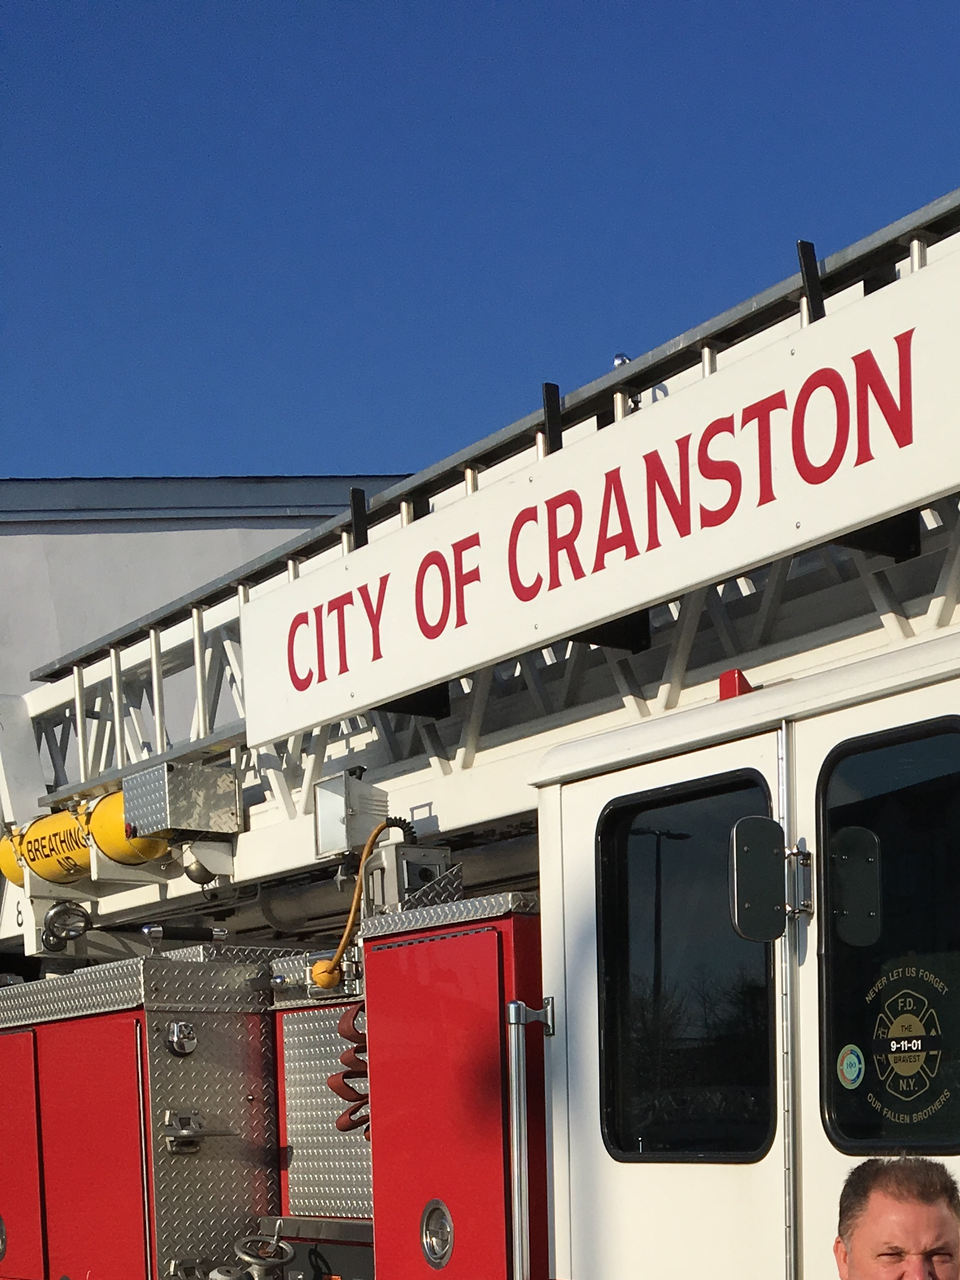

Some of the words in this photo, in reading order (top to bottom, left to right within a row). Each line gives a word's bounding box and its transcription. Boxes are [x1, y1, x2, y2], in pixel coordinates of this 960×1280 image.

[287, 573, 391, 693] CITY
[414, 532, 481, 641] OF
[507, 326, 917, 603] CRANSTON
[865, 976, 888, 1004] NEVER
[889, 968, 903, 981] LET
[905, 967, 917, 977] US
[919, 968, 949, 995] FORGET
[898, 998, 917, 1011] F.D.
[900, 1024, 913, 1032] THE
[890, 1039, 922, 1052] 9-11-01
[894, 1055, 921, 1064] BRAVEST
[899, 1078, 918, 1091] N.Y.
[867, 1092, 882, 1112] OUR
[882, 1107, 910, 1123] FALLEN
[912, 1088, 951, 1122] BROTHERS
